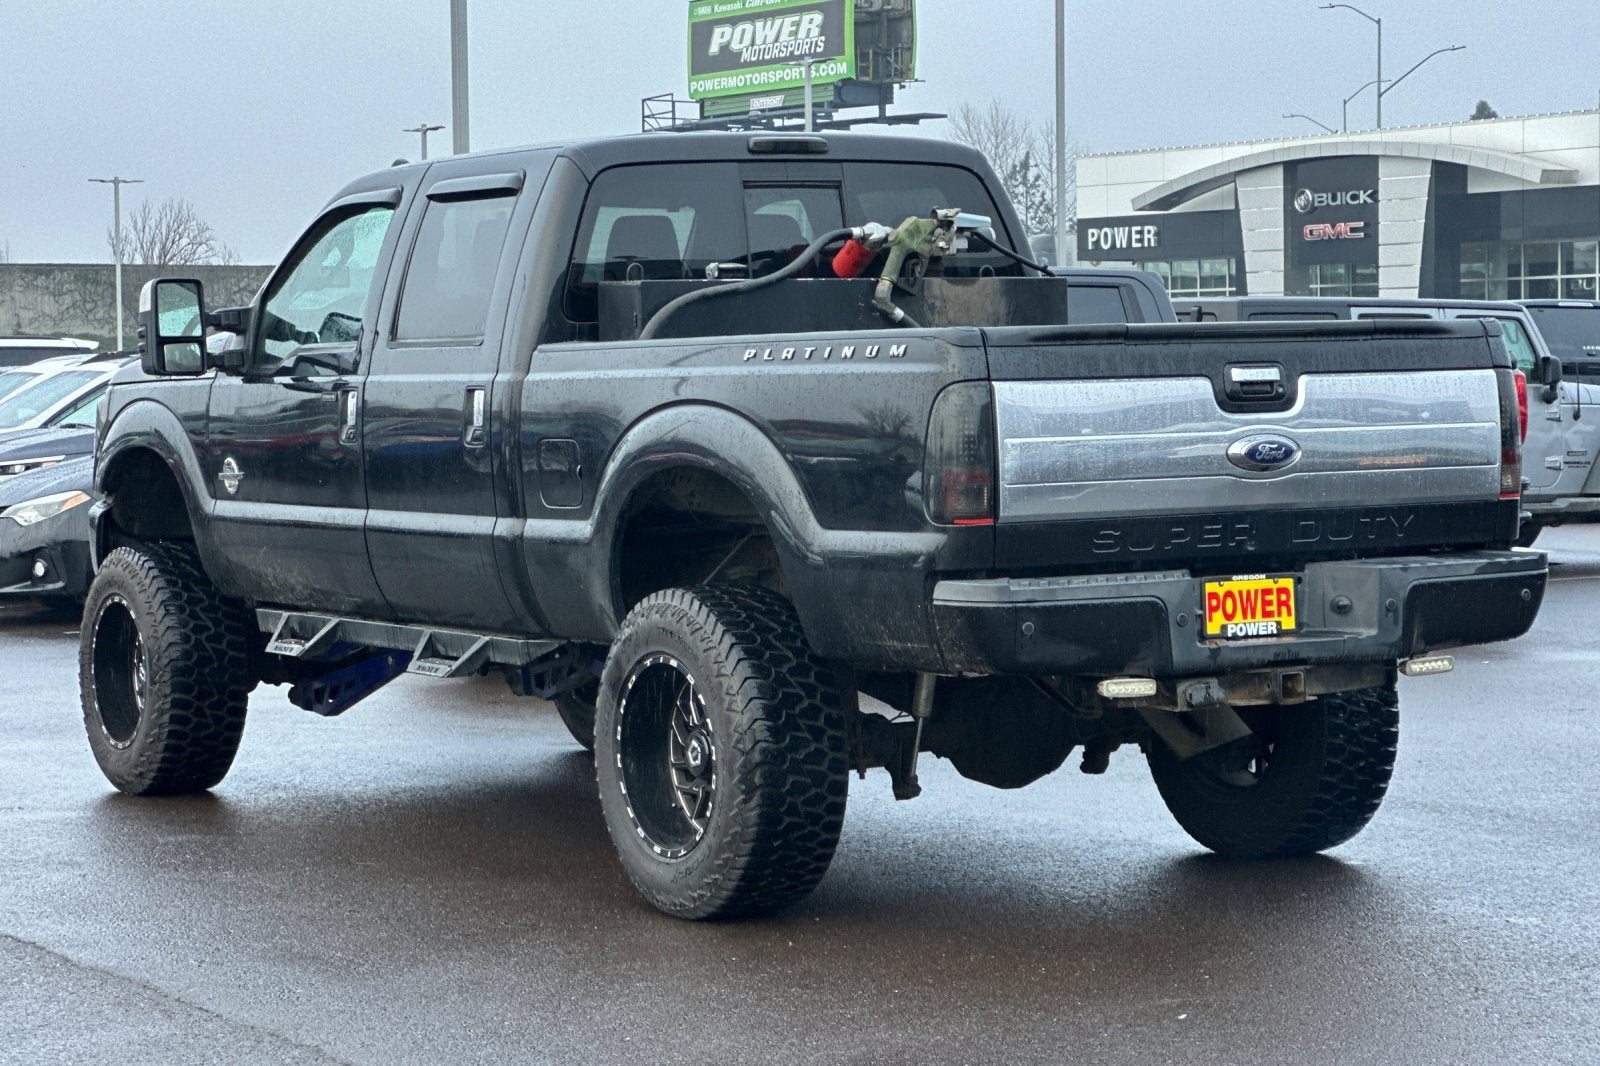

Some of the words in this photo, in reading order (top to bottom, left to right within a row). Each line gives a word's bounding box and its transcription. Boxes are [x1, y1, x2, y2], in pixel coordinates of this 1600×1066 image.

[714, 2, 743, 13] Kawasaki
[708, 10, 825, 56] POWER
[740, 36, 826, 63] MOTORSPORTS
[1314, 189, 1376, 206] BUICK
[1087, 225, 1158, 250] POWER
[1303, 221, 1366, 241] GMC
[743, 344, 907, 361] PLATINUM
[1255, 443, 1285, 460] Ford
[1092, 523, 1256, 553] SUPER
[1292, 514, 1415, 542] DUTY
[1207, 587, 1293, 623] POWER
[1227, 621, 1277, 637] POWER
